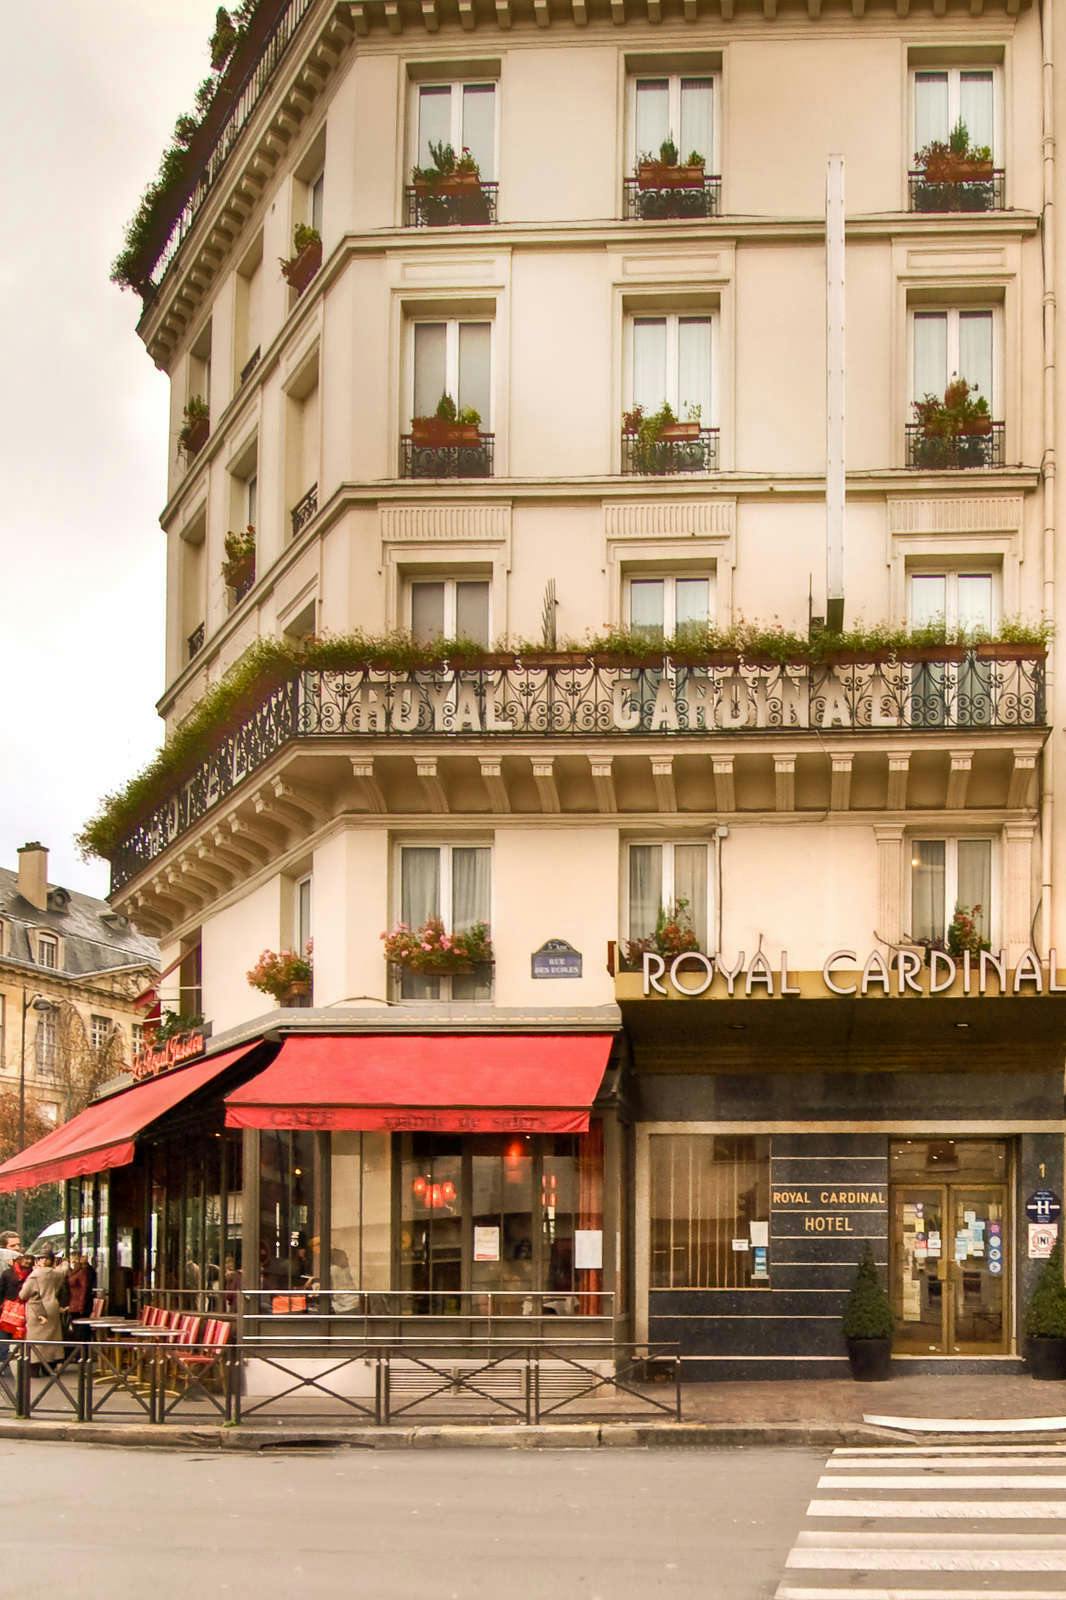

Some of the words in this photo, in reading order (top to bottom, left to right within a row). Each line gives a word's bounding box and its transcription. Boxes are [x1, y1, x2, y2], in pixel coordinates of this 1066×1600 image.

[359, 680, 513, 732] ROYAL
[642, 950, 801, 997] ROYAL
[822, 947, 1066, 996] CARDINAL
[1038, 1163, 1046, 1178] 1
[773, 1191, 811, 1204] ROYAL
[820, 1191, 886, 1204] CARDINAL
[805, 1217, 853, 1231] HOTEL
